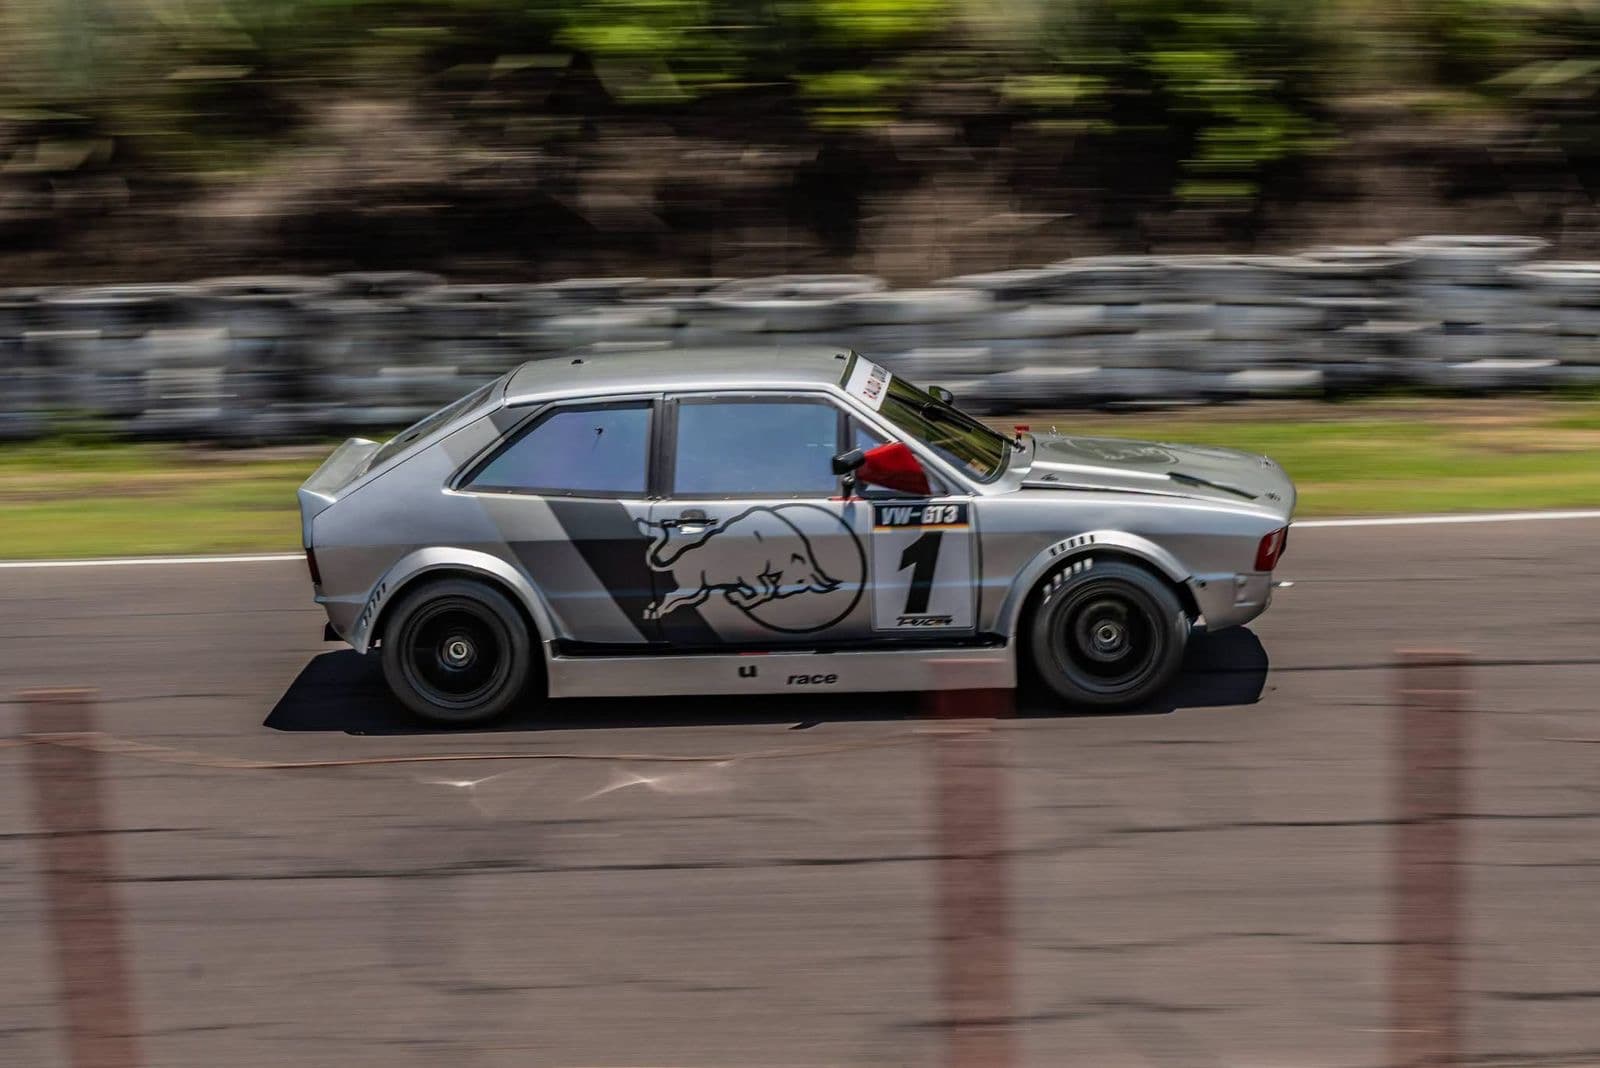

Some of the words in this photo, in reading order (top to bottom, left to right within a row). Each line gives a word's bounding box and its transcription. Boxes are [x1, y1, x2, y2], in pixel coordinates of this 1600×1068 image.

[881, 504, 959, 526] VW-GT3
[897, 531, 944, 615] 1
[738, 665, 758, 678] u
[785, 673, 838, 686] race
